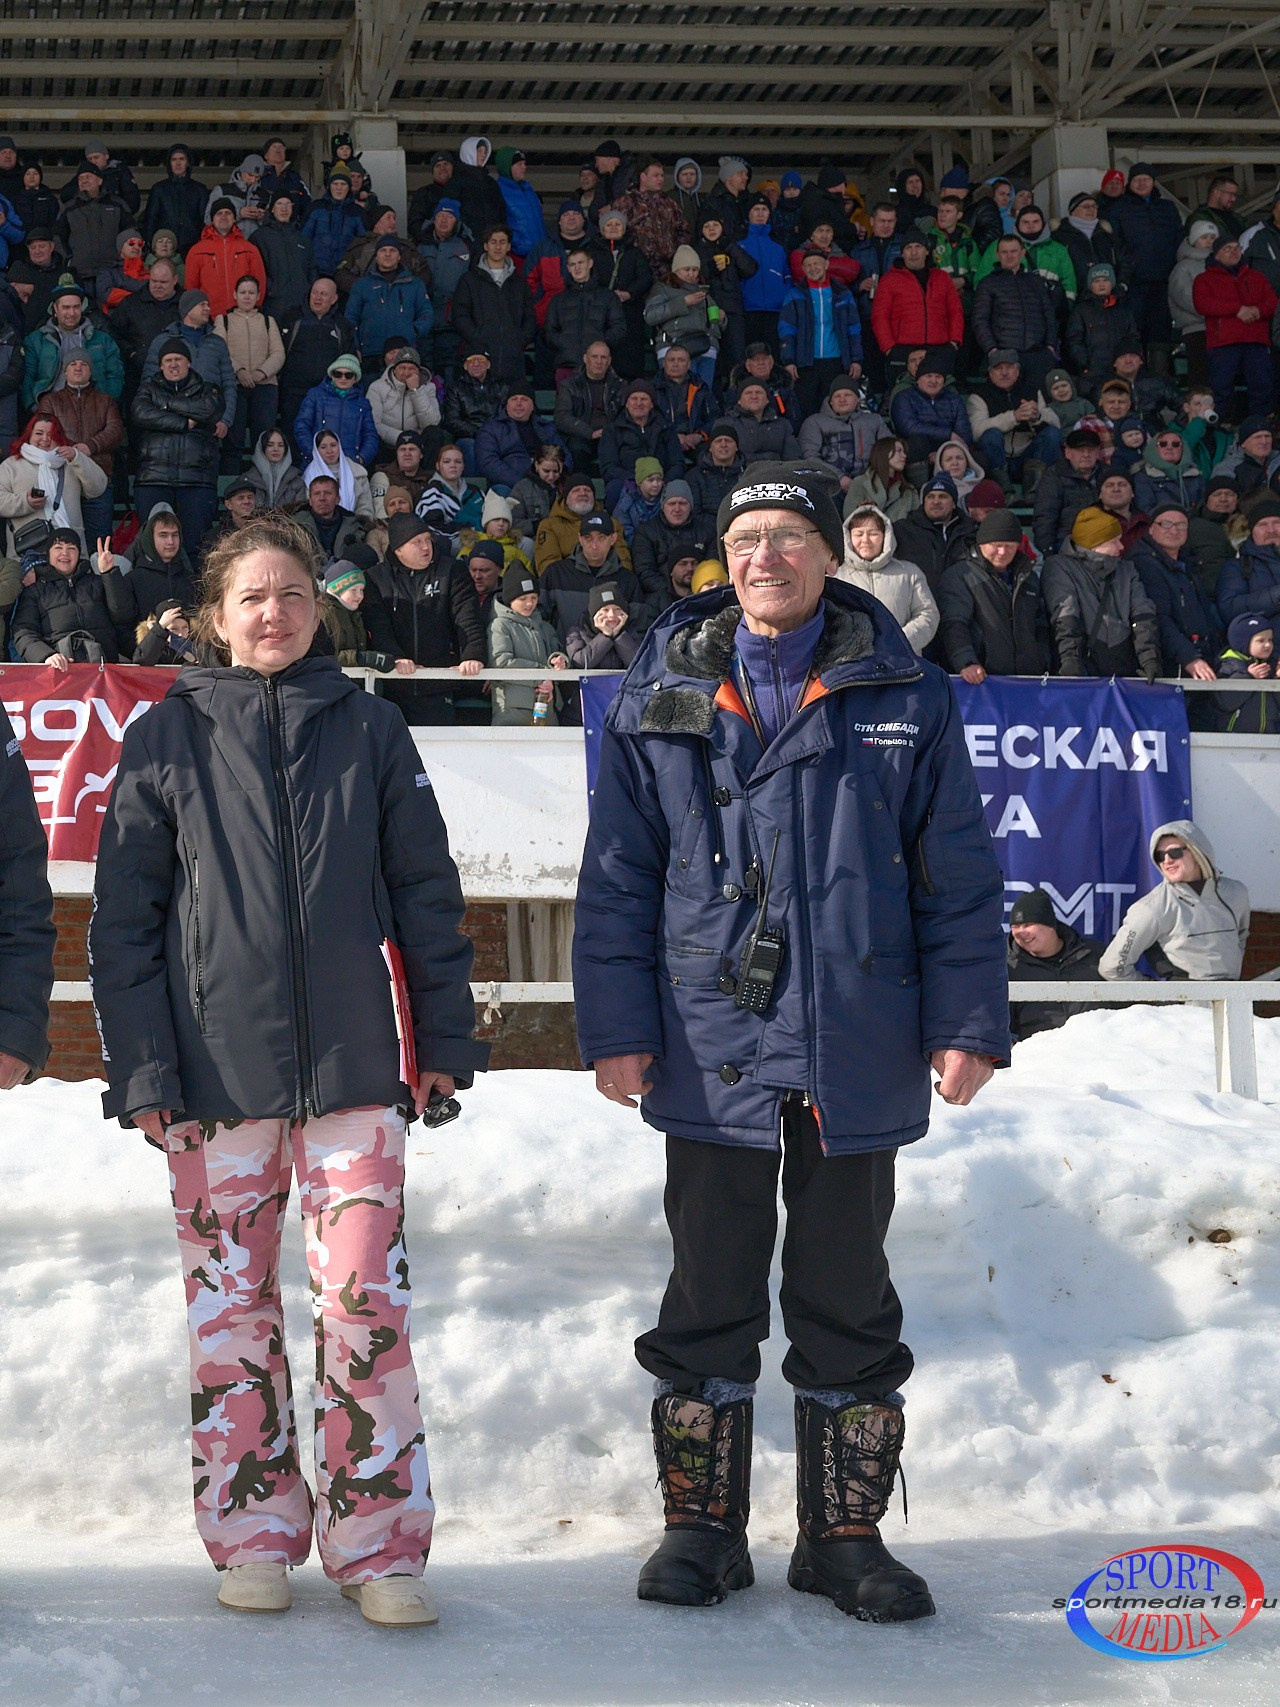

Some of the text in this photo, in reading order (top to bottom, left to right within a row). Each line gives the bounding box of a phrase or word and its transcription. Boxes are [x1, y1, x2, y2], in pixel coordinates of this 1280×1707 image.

[853, 722, 919, 734] СТК СИБАДИ
[874, 737, 907, 746] Гольцов
